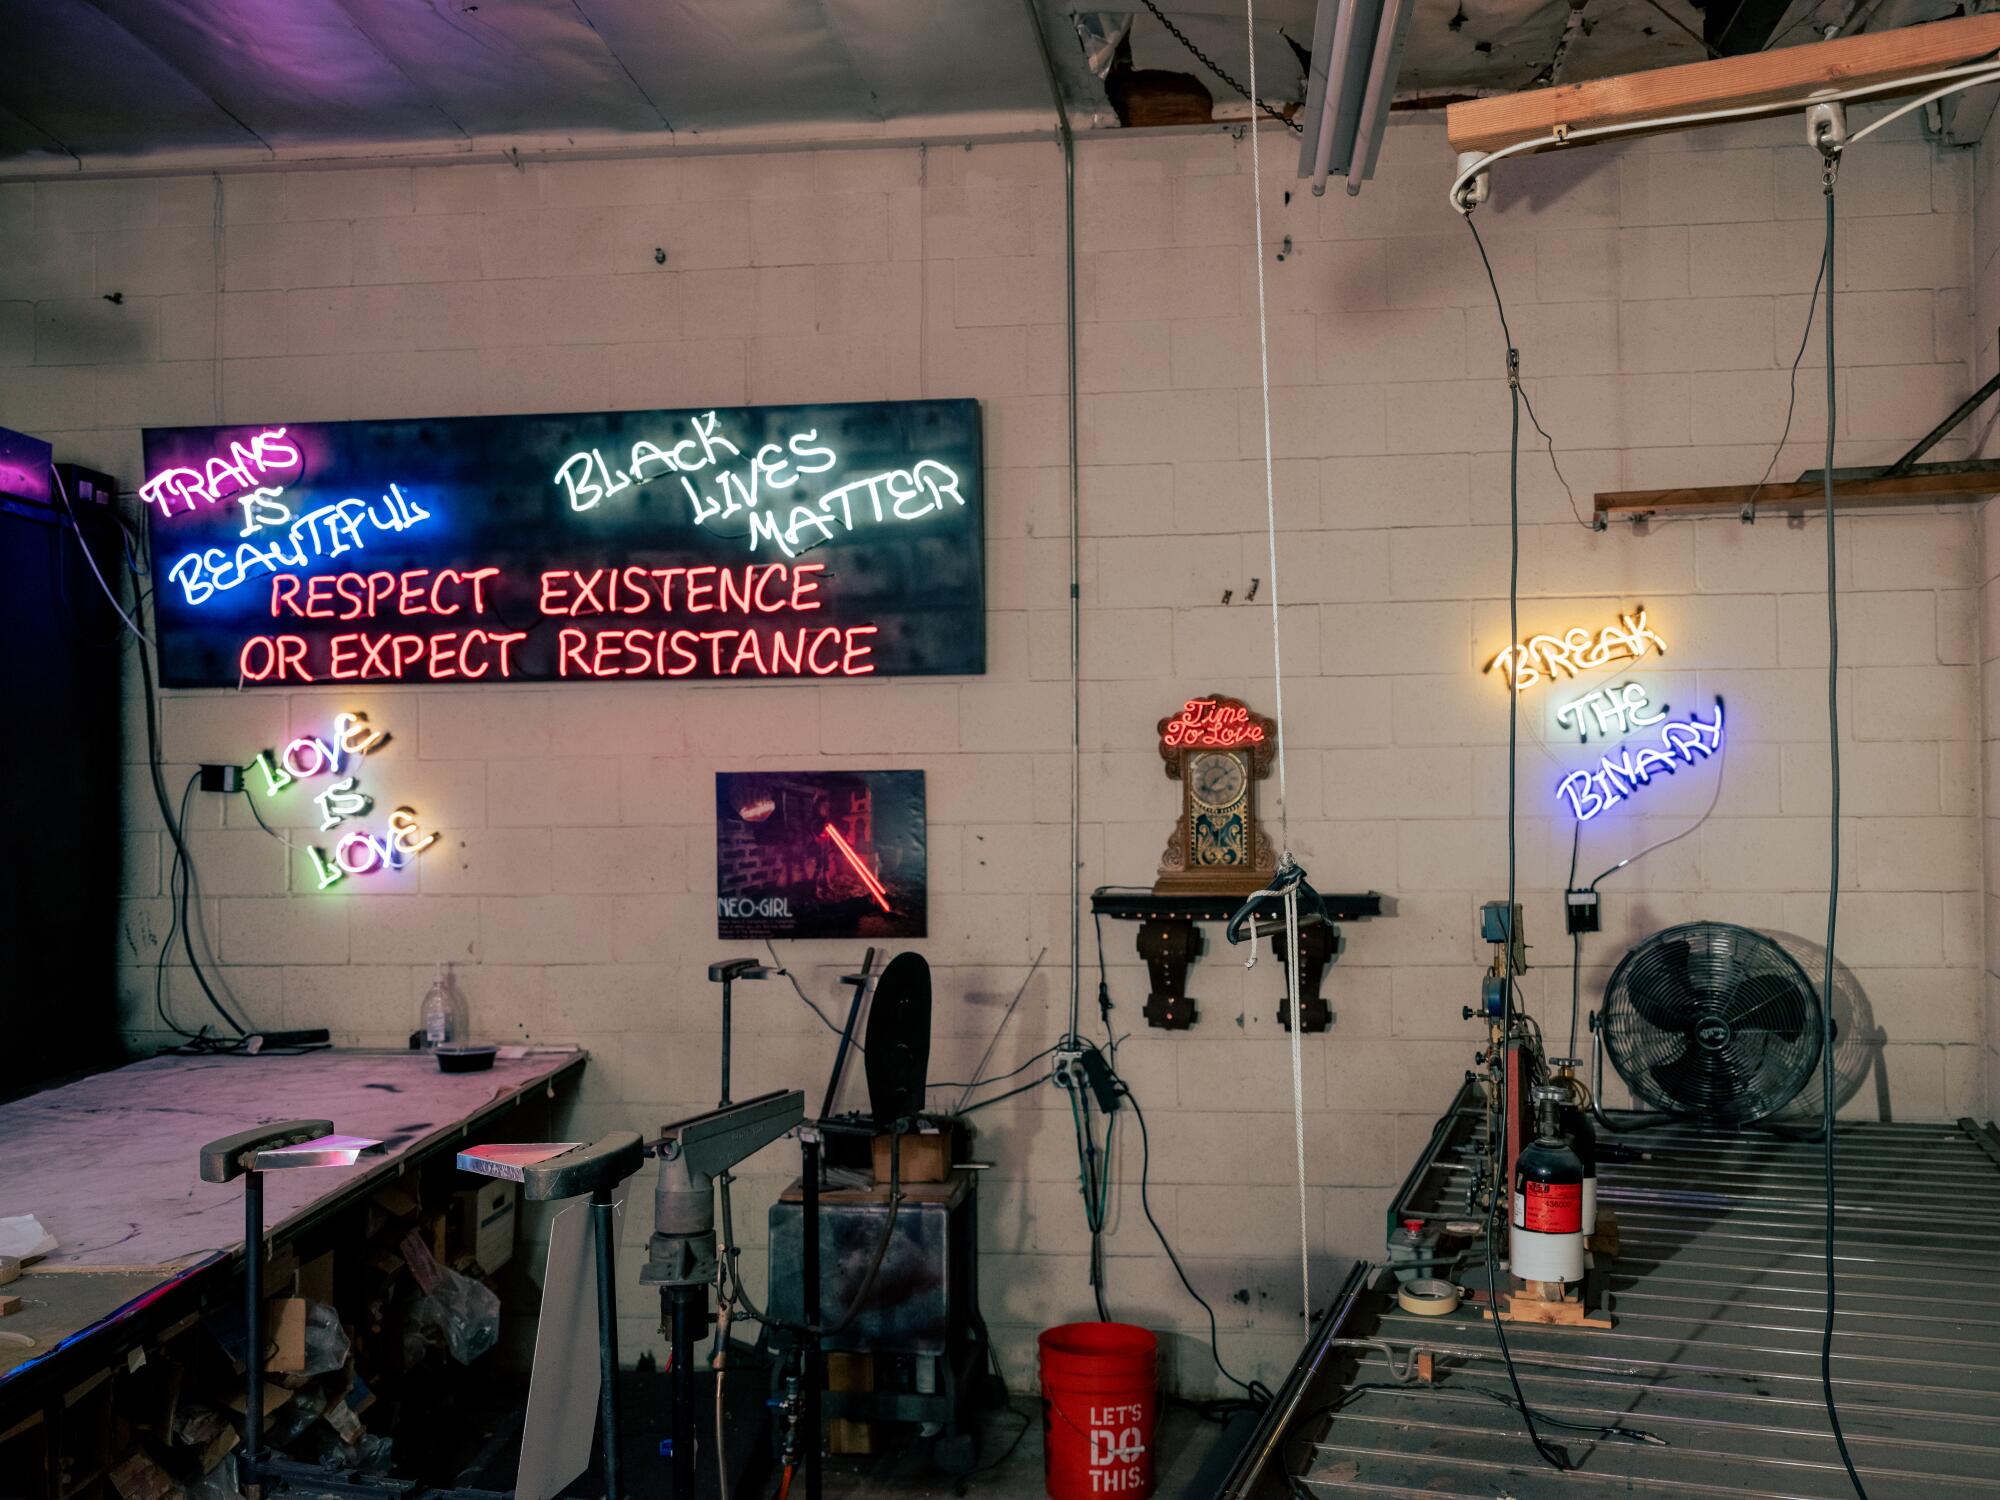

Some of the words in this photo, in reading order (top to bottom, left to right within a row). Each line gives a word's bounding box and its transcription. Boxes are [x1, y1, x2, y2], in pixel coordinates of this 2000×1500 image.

[139, 427, 298, 517] TRANS
[554, 411, 740, 511] BLACK
[681, 429, 837, 524] LIVES
[238, 486, 290, 537] IS
[749, 459, 966, 558] MATTER
[168, 483, 431, 605] BEAUTIFUL
[271, 567, 500, 620] RESPECT
[539, 563, 826, 616] EXISTENCE
[239, 633, 314, 682] OR
[330, 628, 527, 680] EXPECT
[558, 626, 878, 677] RESISTANCE
[1493, 611, 1667, 690] BREAK
[1164, 720, 1204, 746] To
[1202, 722, 1265, 746] Love
[1182, 700, 1249, 727] Time
[1557, 683, 1667, 735] THE
[256, 712, 380, 797] LOVE
[1556, 705, 1722, 821] BINARY
[314, 777, 366, 832] IS
[306, 810, 435, 890] LOVE
[1090, 1403, 1142, 1426] LET'S
[1090, 1427, 1142, 1466] DO
[1088, 1466, 1145, 1492] THIS.
